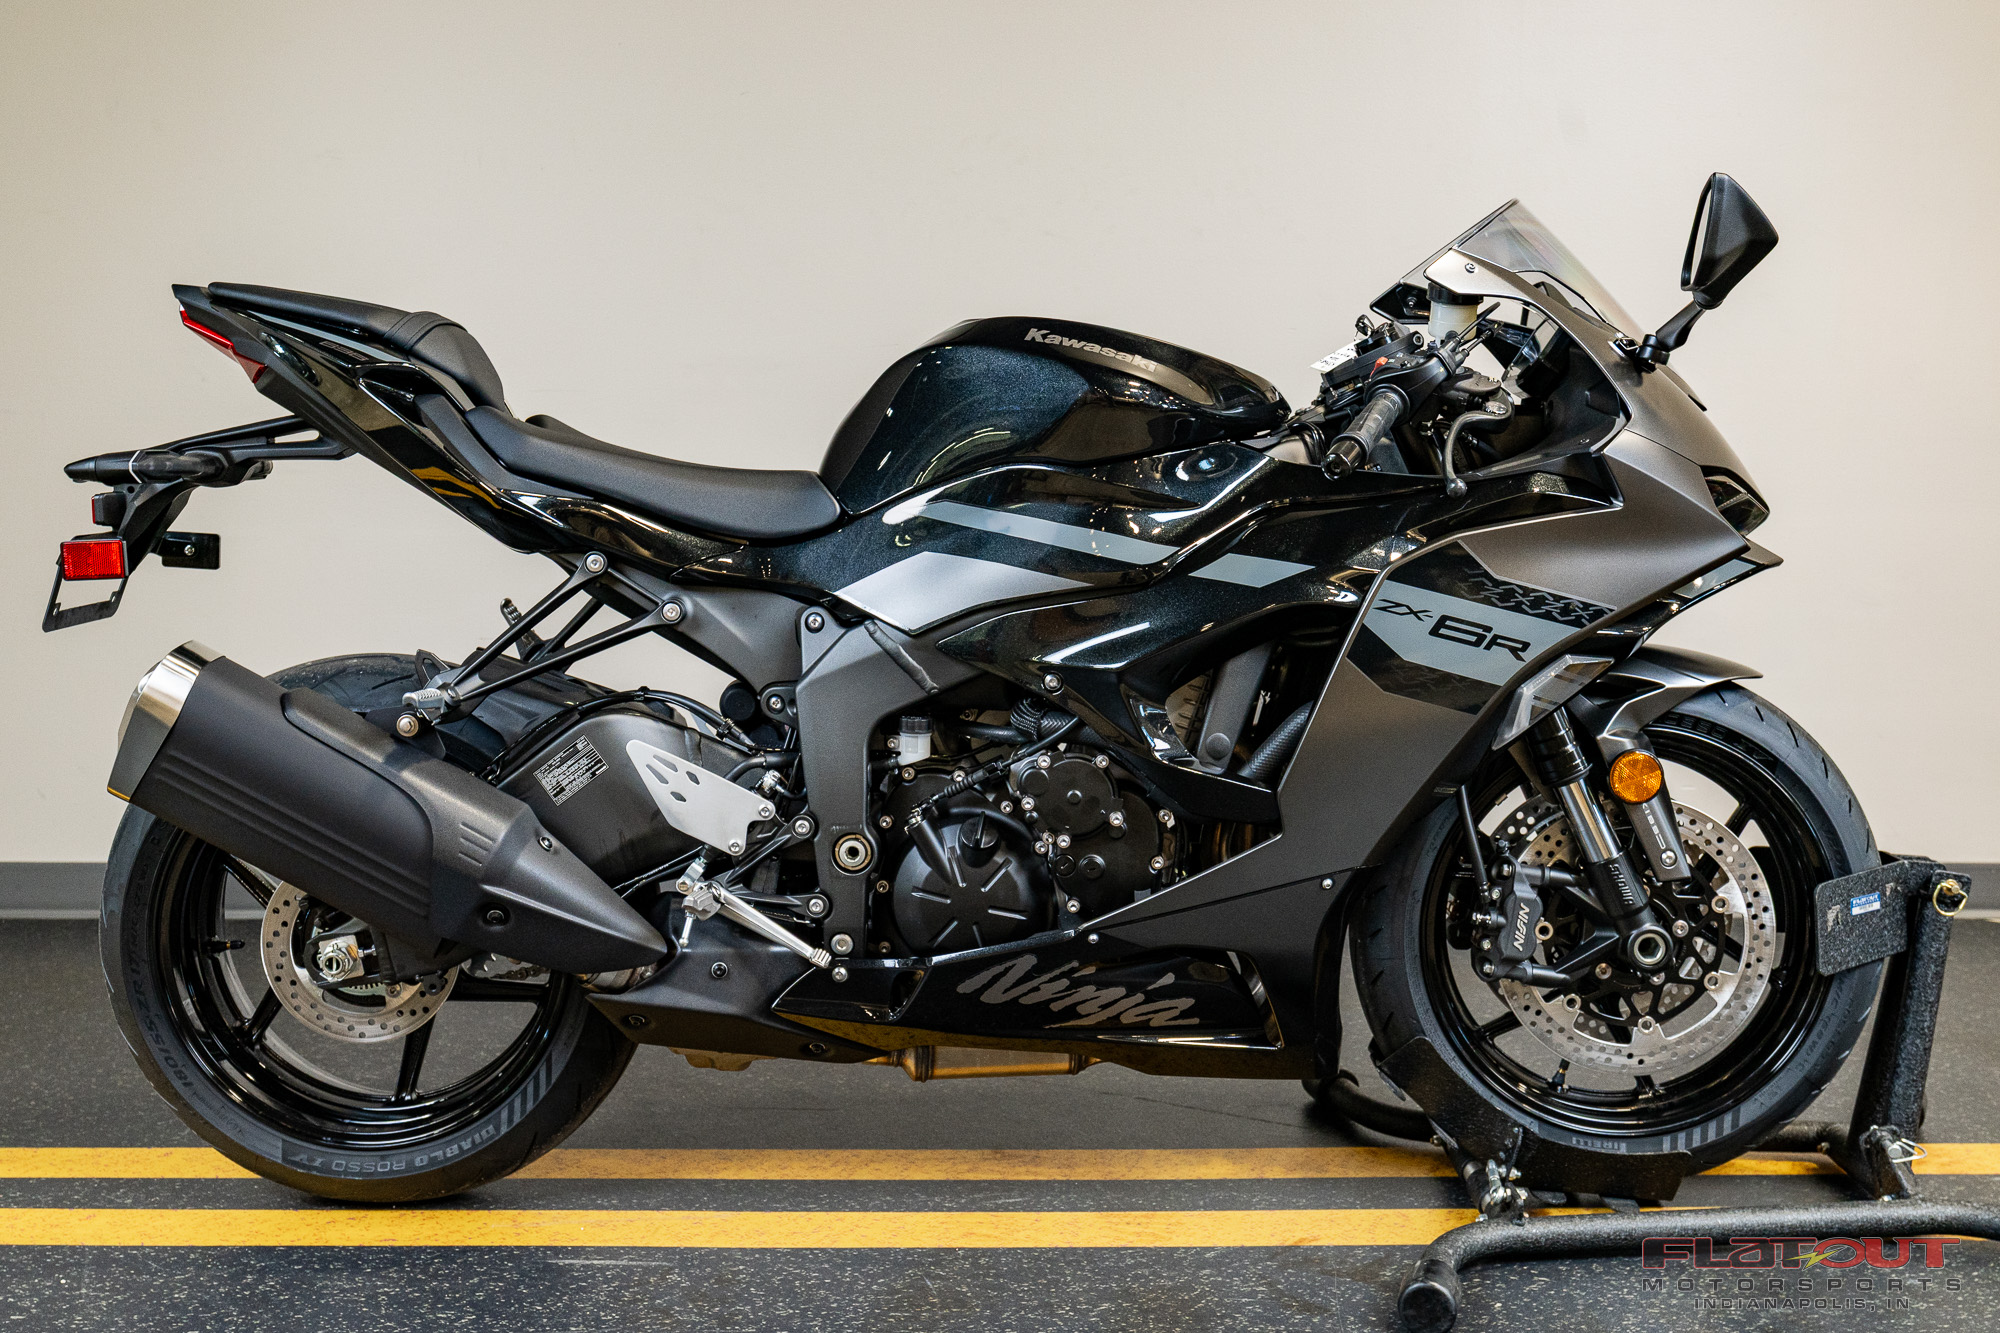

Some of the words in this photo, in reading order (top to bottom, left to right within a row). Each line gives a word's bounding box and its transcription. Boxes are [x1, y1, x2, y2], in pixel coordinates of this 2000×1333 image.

[1024, 328, 1159, 373] Kawasaki
[956, 953, 1200, 1029] Ninja
[331, 1159, 406, 1173] ROSSO
[414, 1124, 496, 1167] DIABLO
